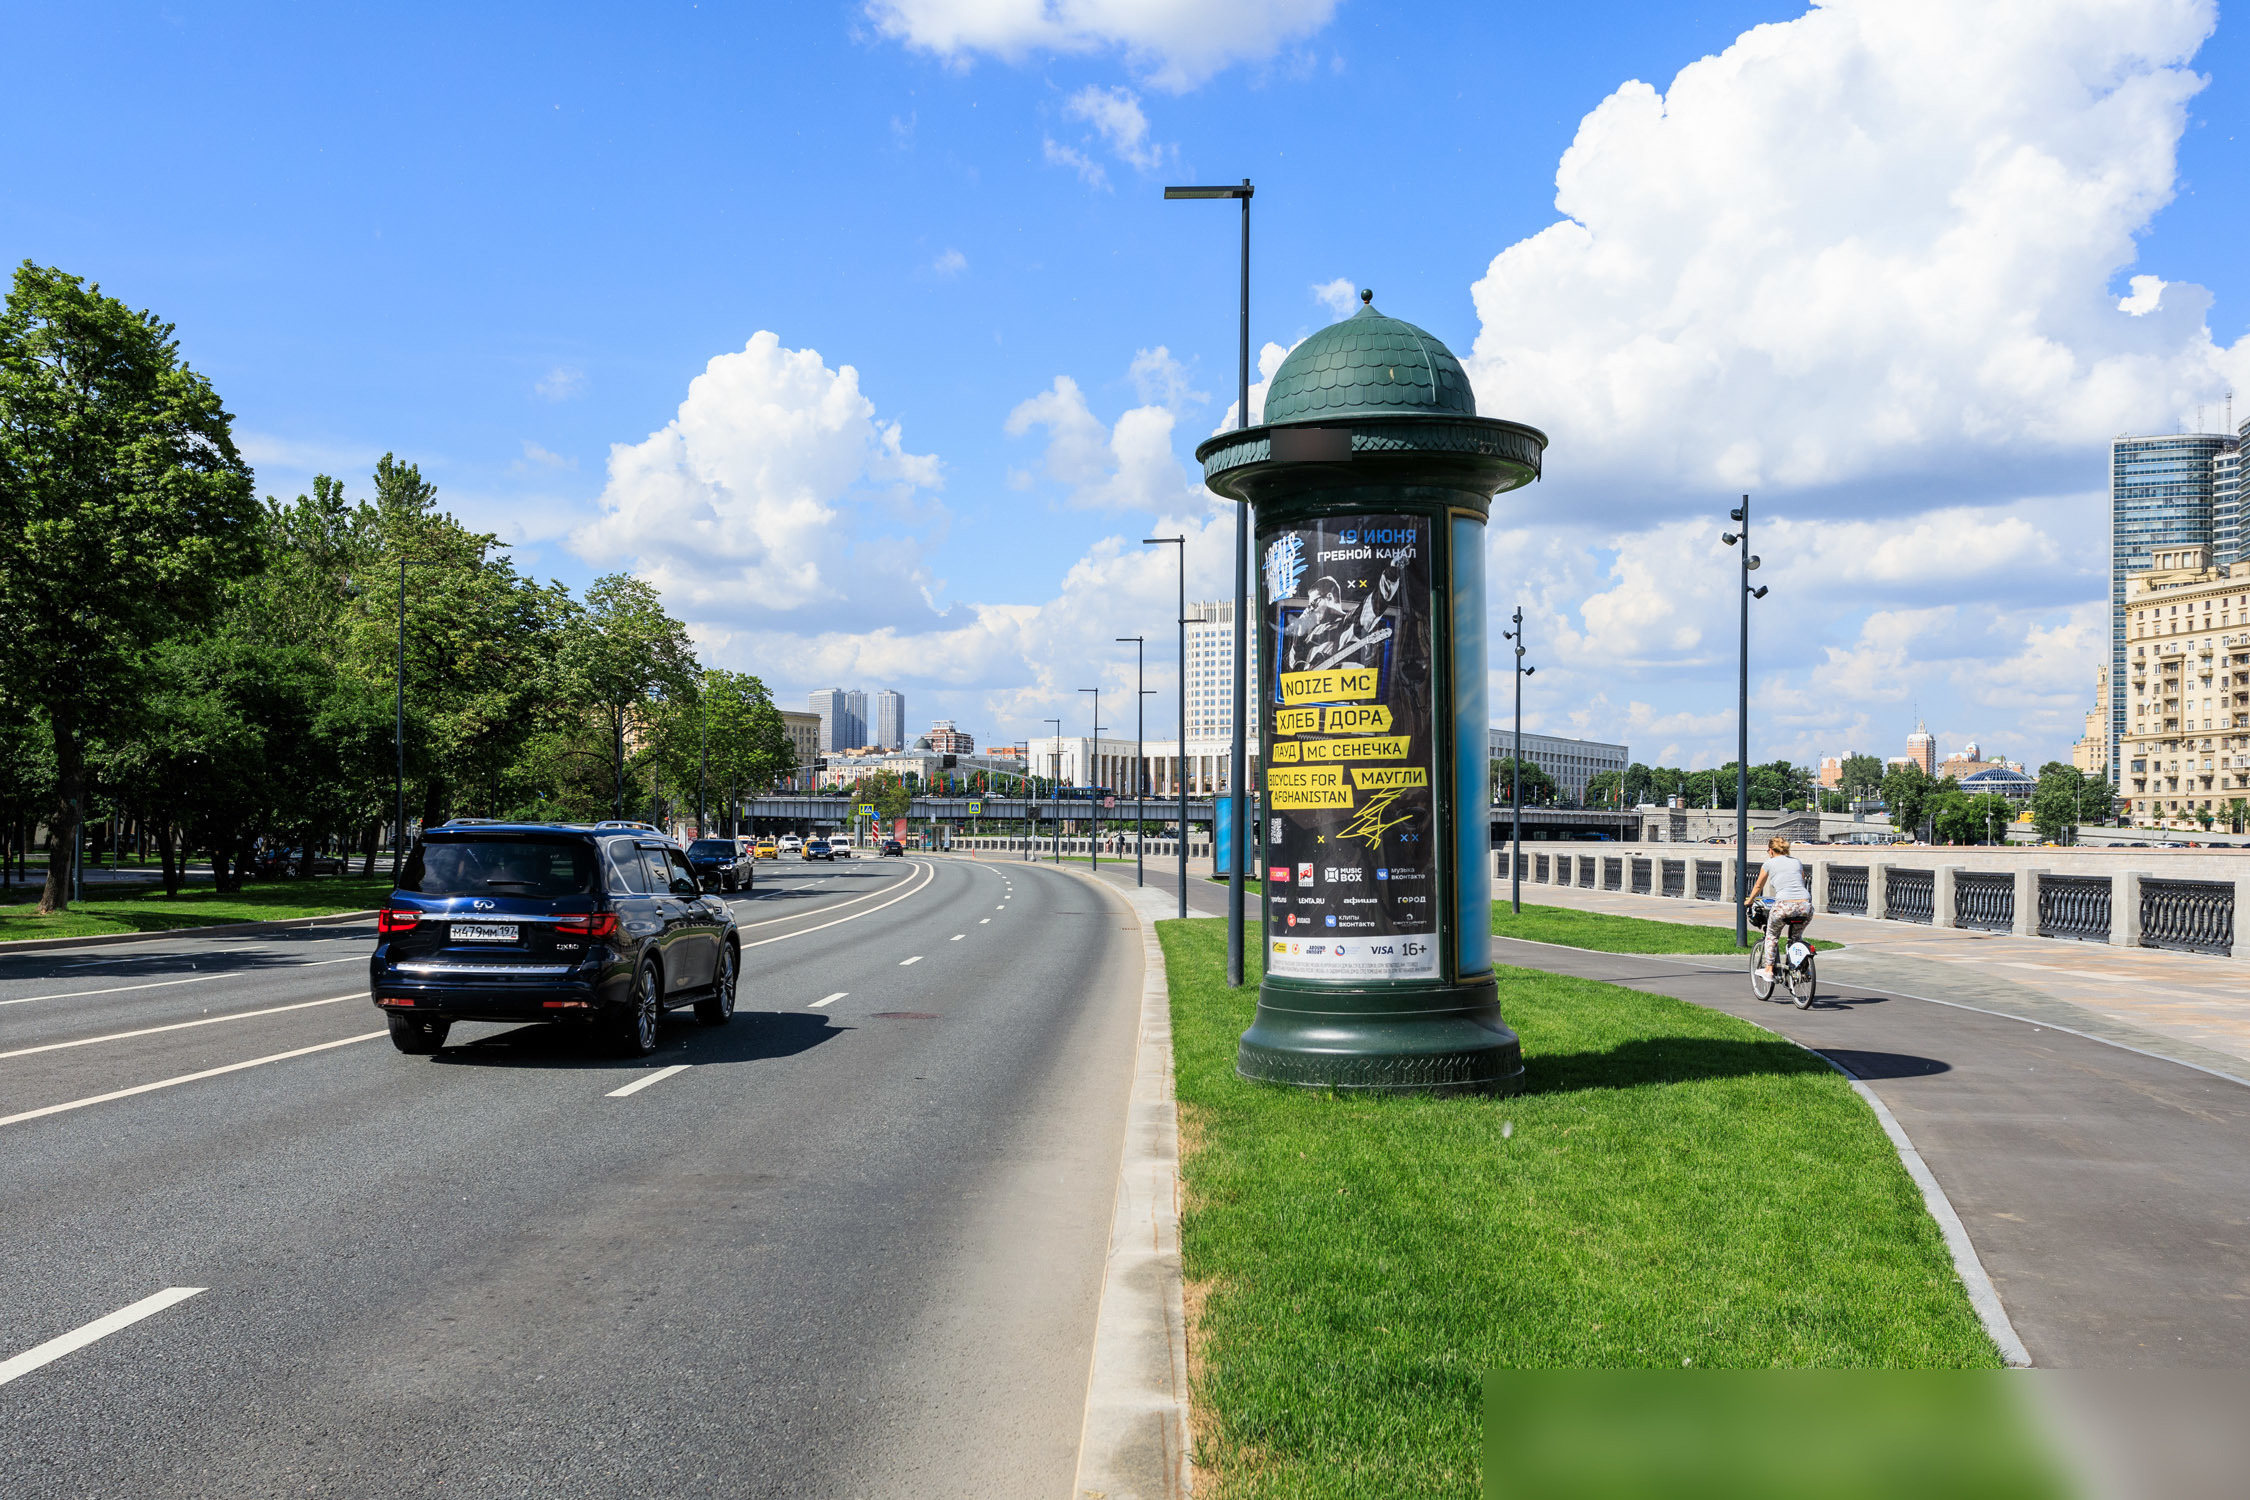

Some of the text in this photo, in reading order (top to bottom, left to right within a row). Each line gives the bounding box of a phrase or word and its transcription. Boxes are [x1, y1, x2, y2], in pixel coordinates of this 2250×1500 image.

[1338, 529, 1417, 544] 19 ИЮНЯ
[1317, 546, 1417, 562] ГРЕБНОЙ КАНАЛ
[1285, 675, 1371, 696] NOIZE MC
[1279, 712, 1315, 730] ХЛЕБ
[1329, 709, 1384, 730] ДОРА
[1332, 742, 1402, 757] СЕНЕЧКА
[1269, 773, 1337, 786] BICYCLES FOR
[1361, 771, 1423, 785] МАУГЛИ
[1274, 790, 1347, 803] AFGHANISTAN
[1340, 873, 1363, 882] BOX
[1343, 896, 1378, 906] афиша
[499, 926, 516, 935] 197
[1370, 945, 1394, 955] VISA
[1402, 942, 1427, 956] 16+
